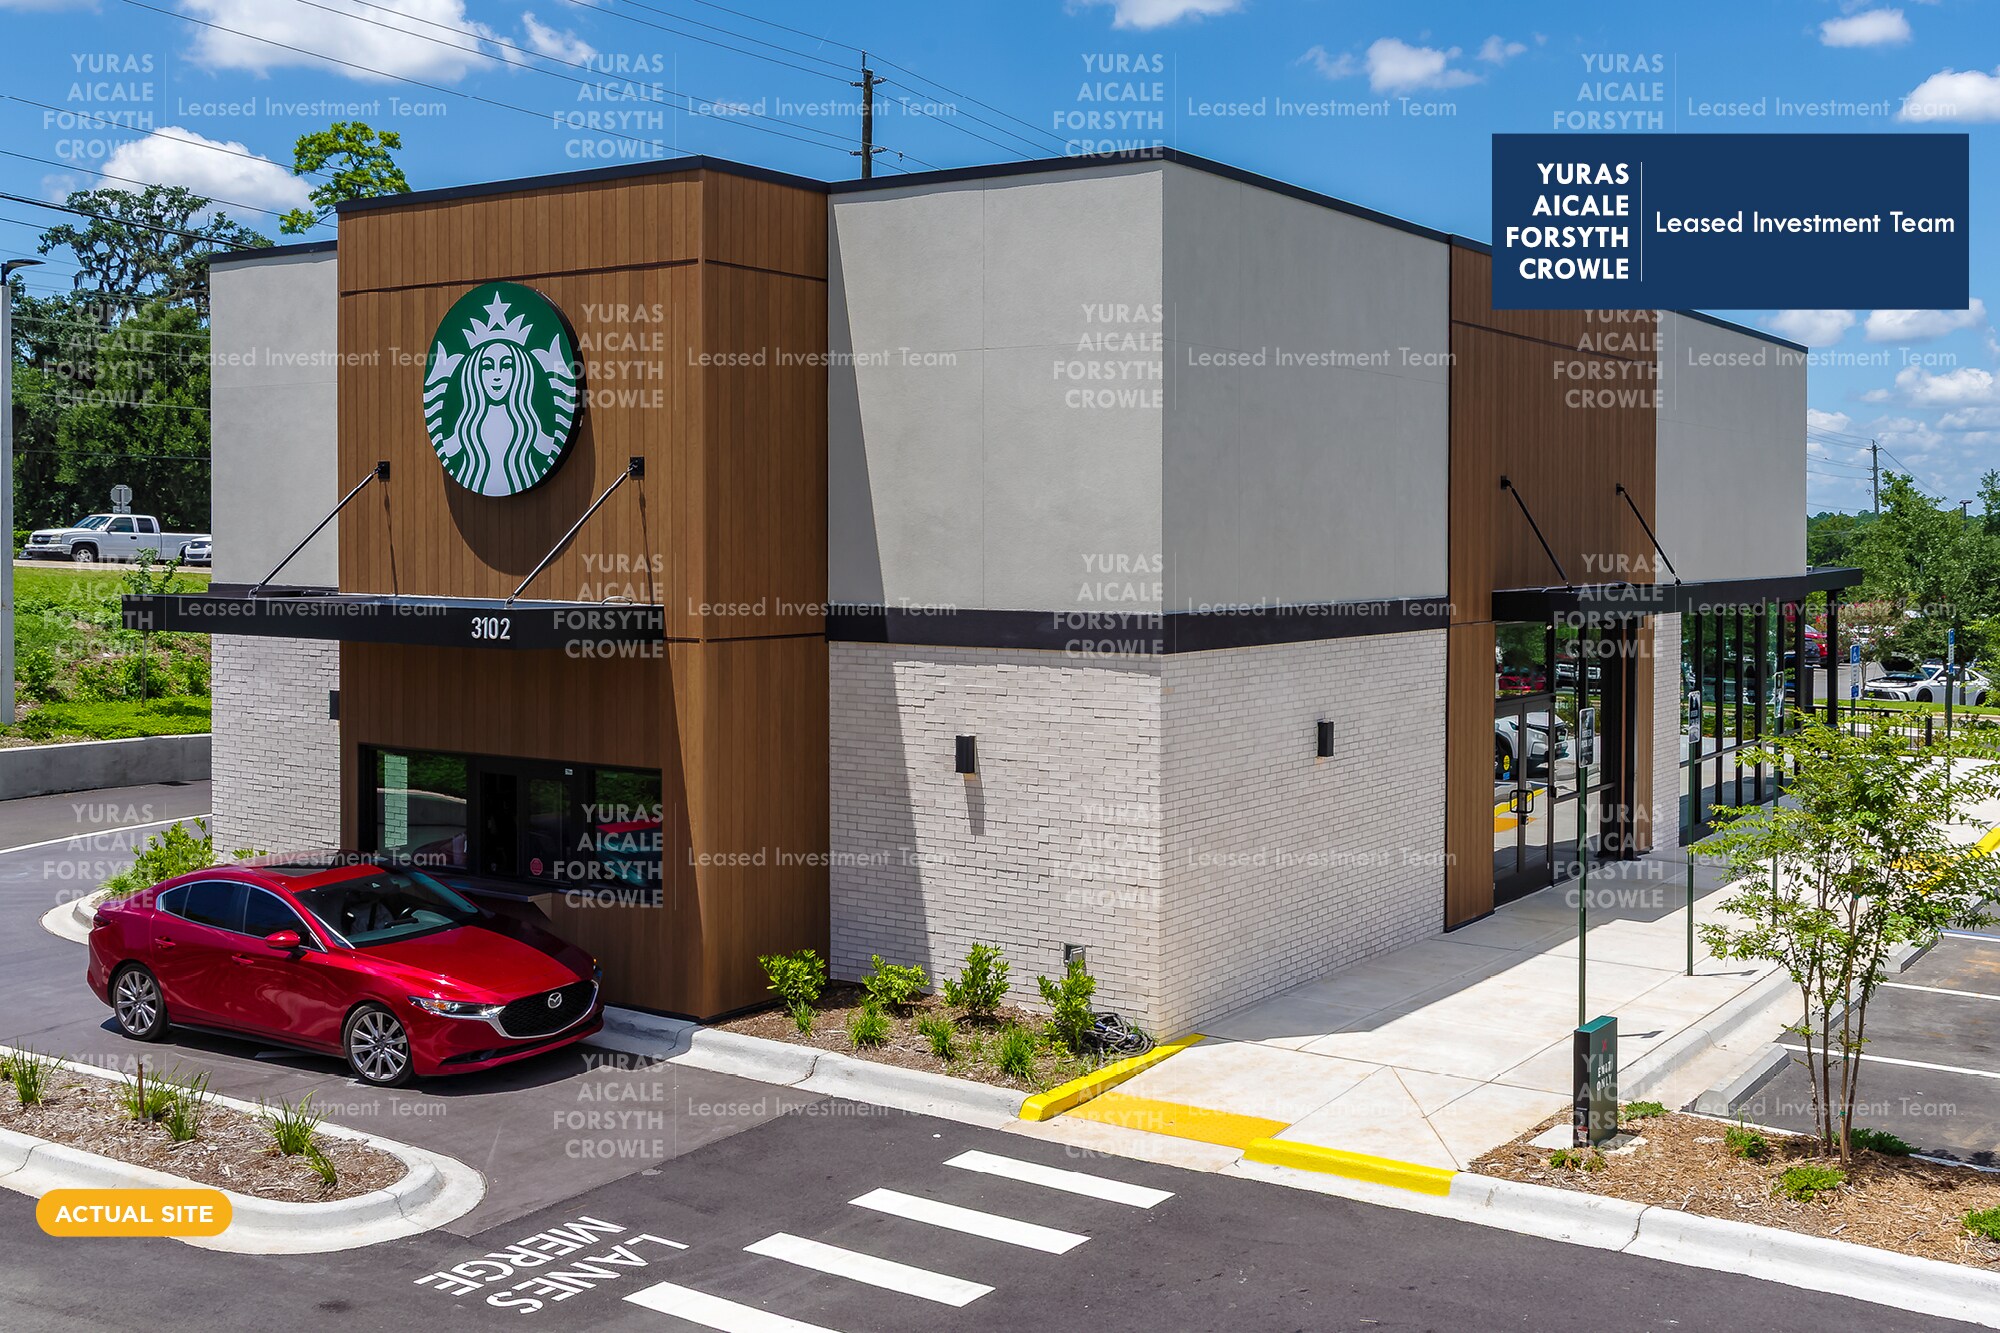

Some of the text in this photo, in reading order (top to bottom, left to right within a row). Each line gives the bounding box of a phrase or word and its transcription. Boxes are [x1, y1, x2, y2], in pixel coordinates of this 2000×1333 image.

[471, 616, 511, 640] 3102
[1597, 1073, 1612, 1091] ONLY
[413, 1215, 627, 1296] MERGE
[486, 1233, 690, 1314] LANES
